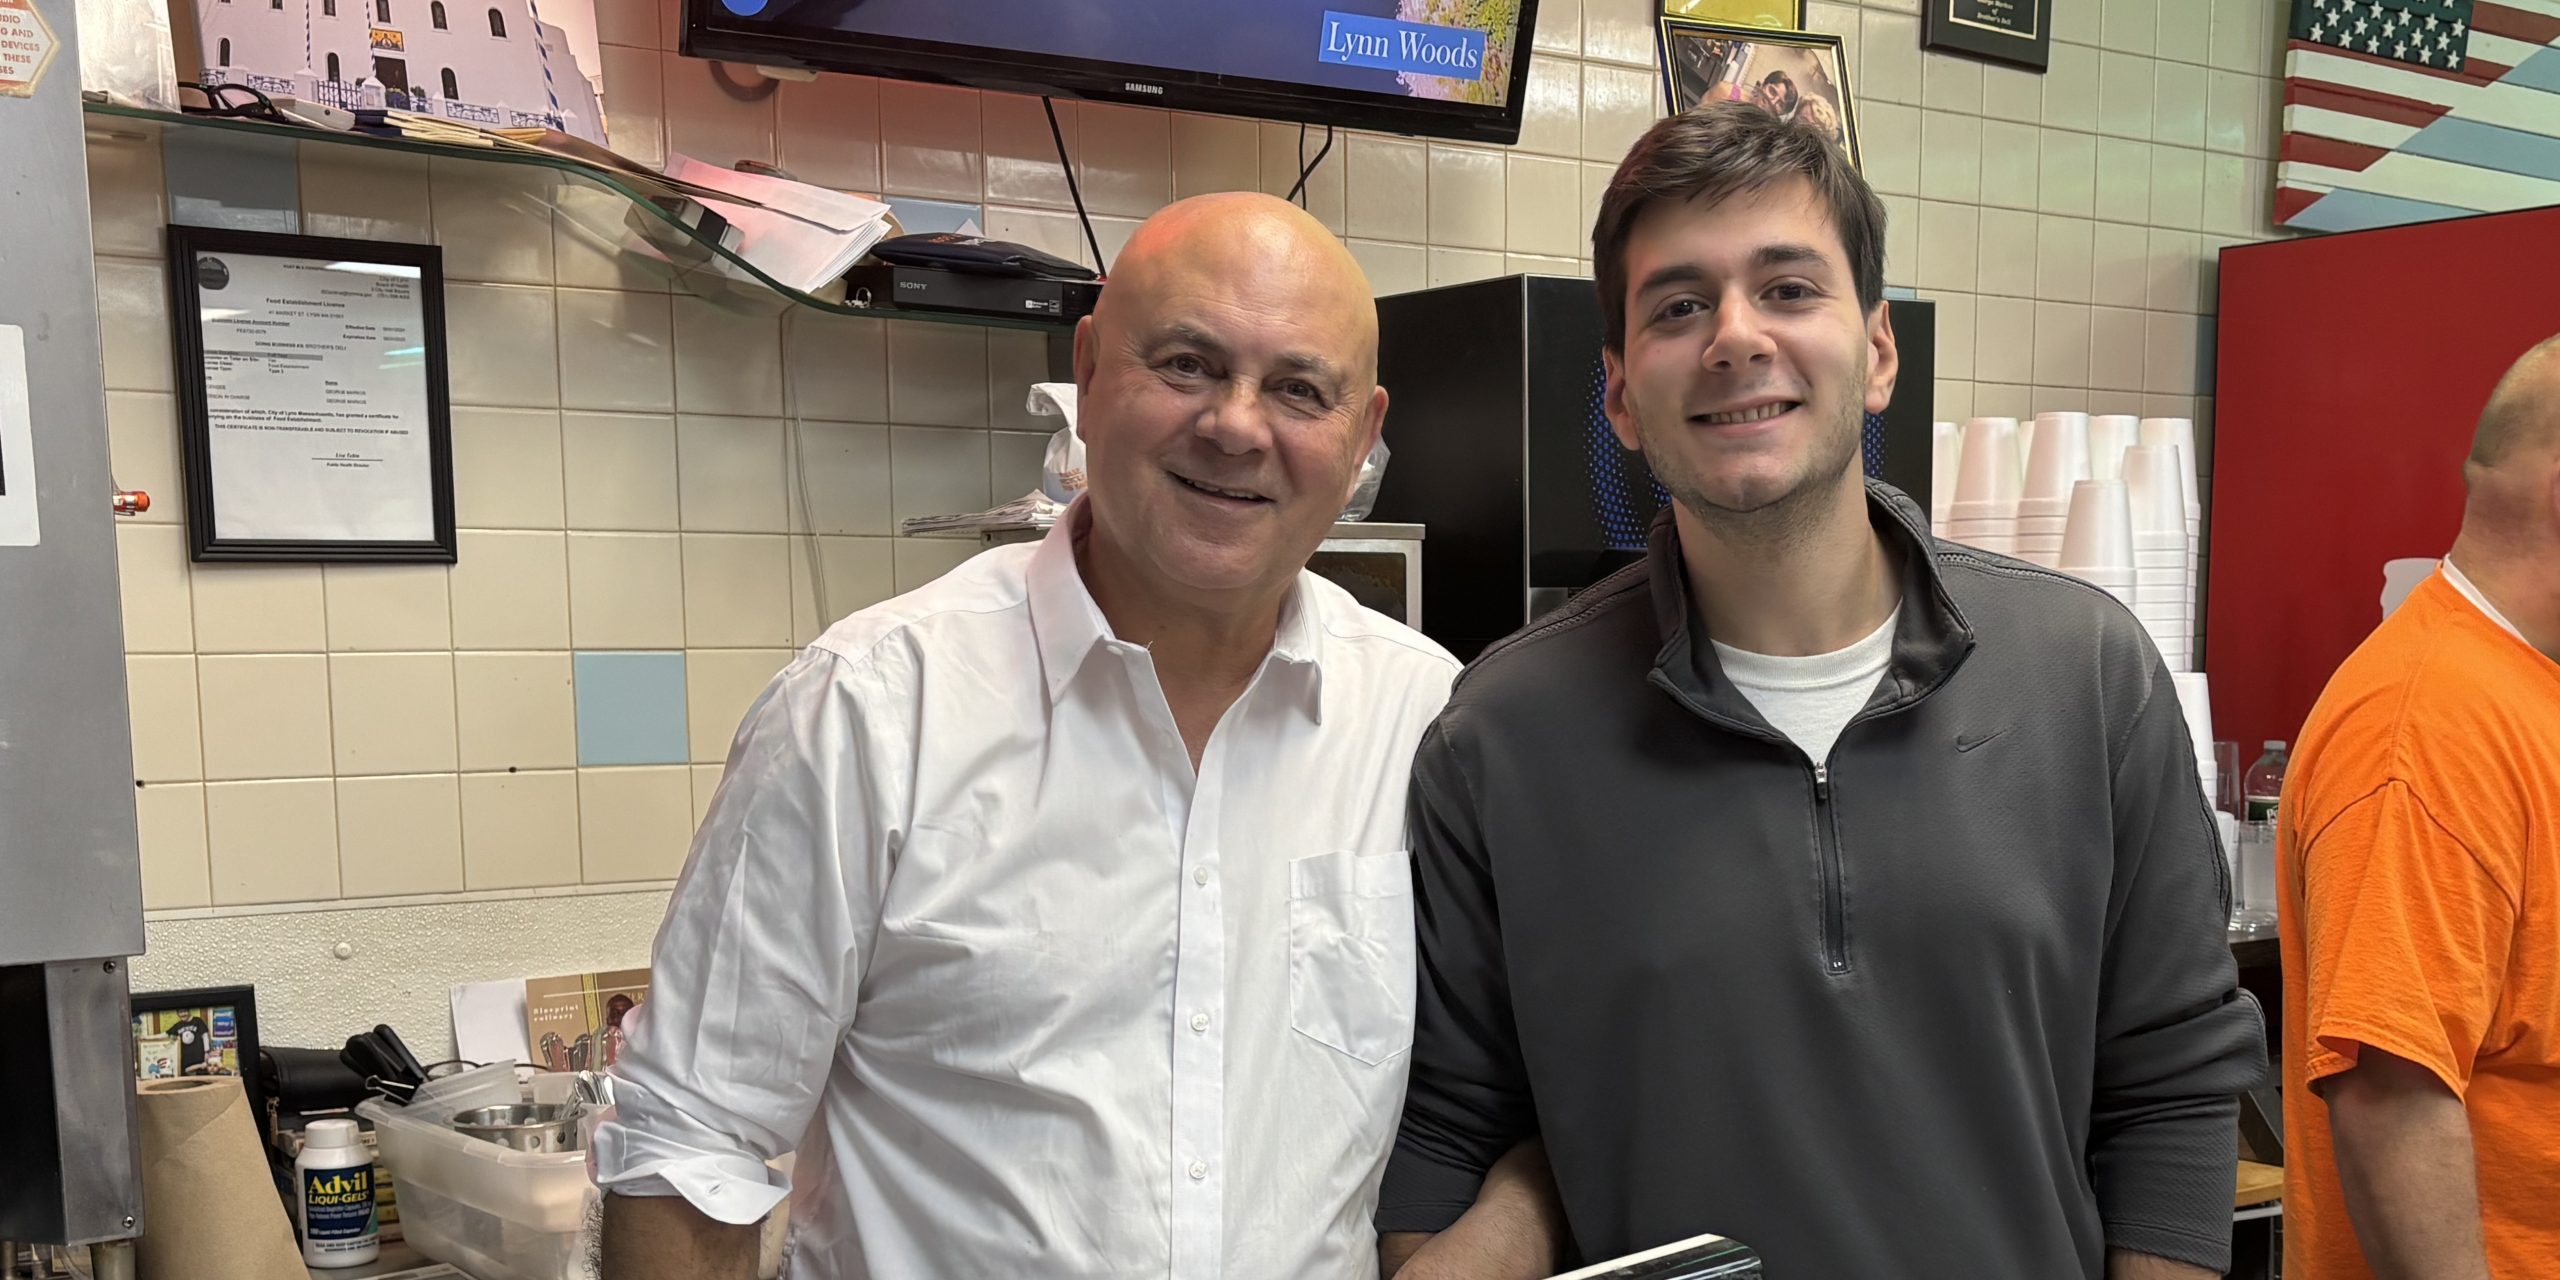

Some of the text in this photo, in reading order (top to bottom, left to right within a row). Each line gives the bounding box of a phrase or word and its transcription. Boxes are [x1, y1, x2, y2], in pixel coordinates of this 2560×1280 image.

[12, 28, 34, 38] AND
[1, 40, 40, 52] DEVICES
[1327, 21, 1478, 69] Lynn Woods
[3, 53, 31, 64] THESE
[1125, 82, 1164, 95] SAMSUNG
[899, 281, 928, 291] SONY
[282, 298, 322, 306] Establishment
[308, 1171, 368, 1194] Advil
[309, 1191, 367, 1206] LIQUI-GELS
